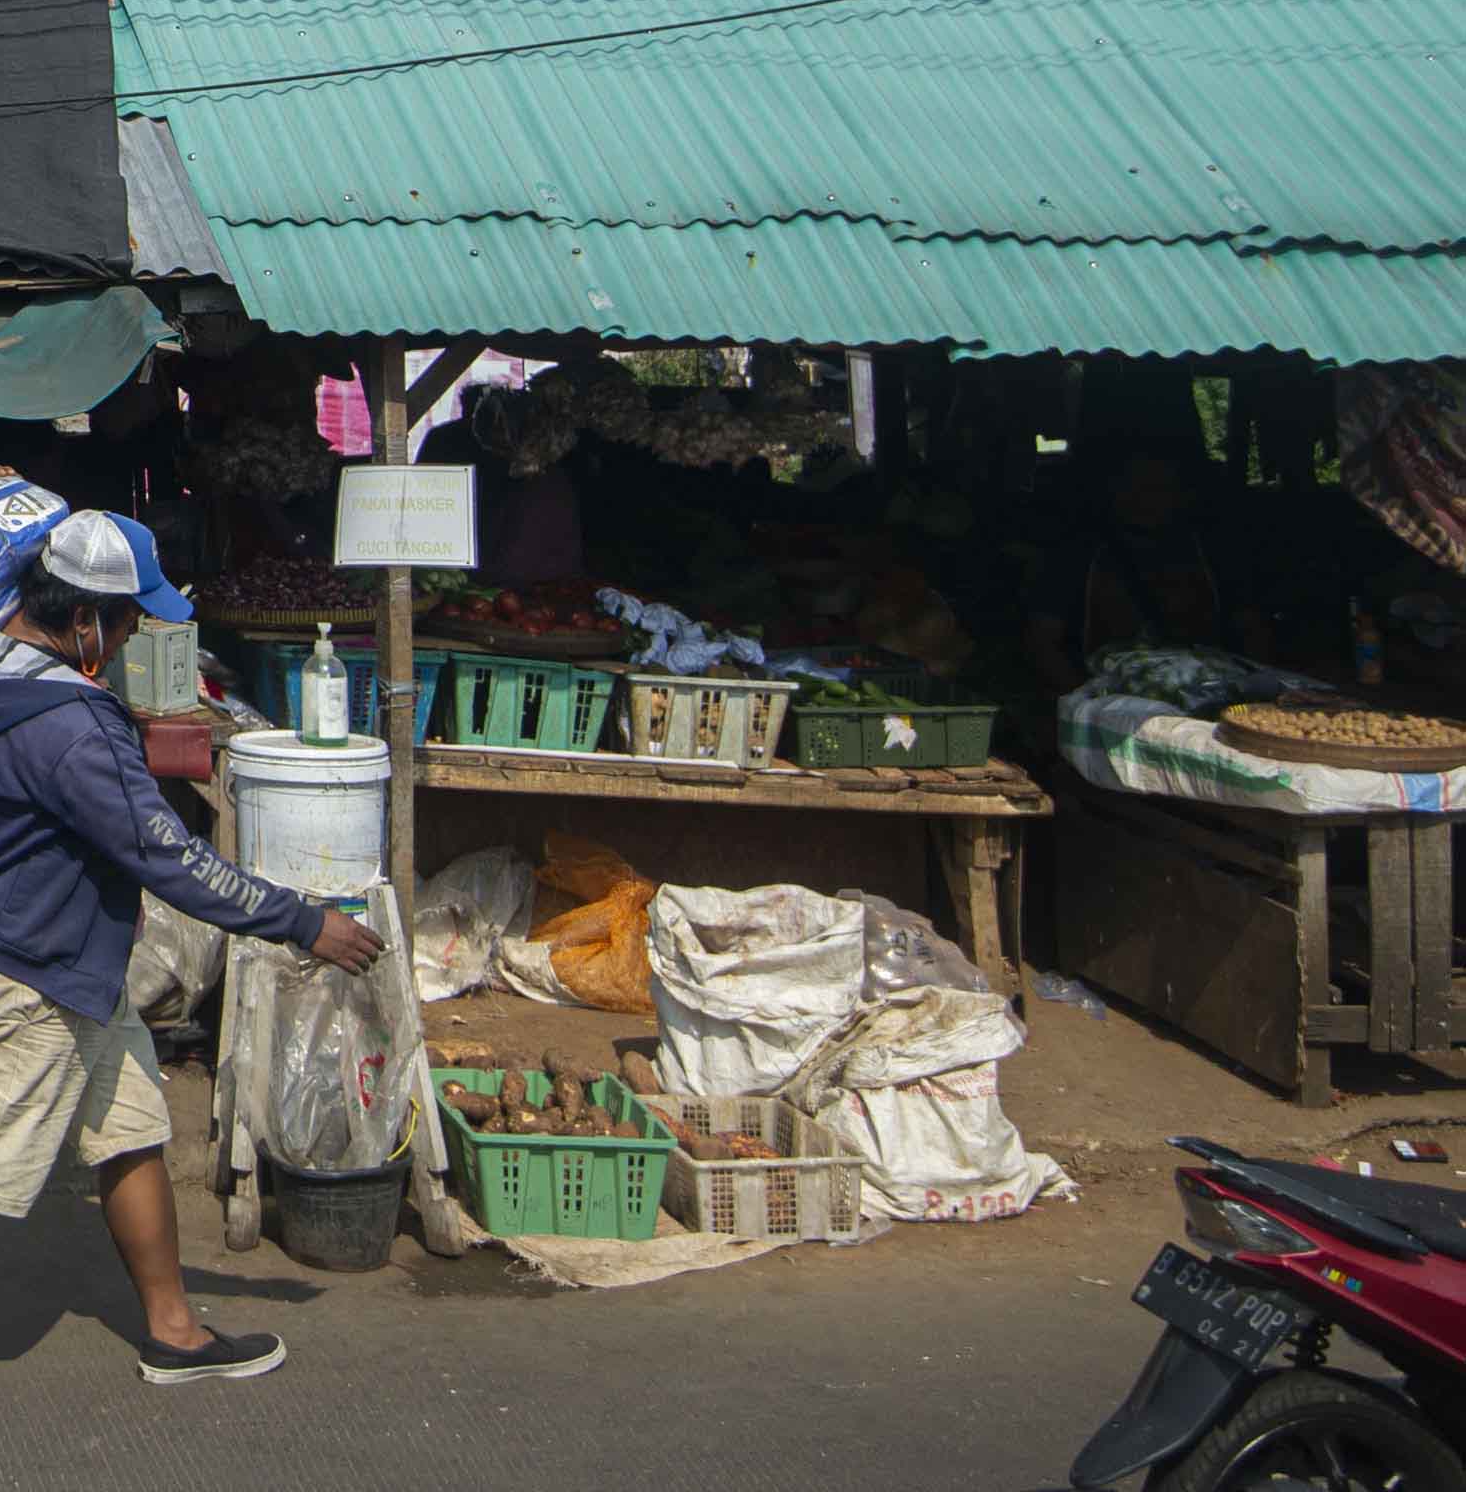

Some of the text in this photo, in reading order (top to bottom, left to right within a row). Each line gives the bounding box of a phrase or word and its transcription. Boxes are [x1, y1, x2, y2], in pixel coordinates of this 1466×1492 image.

[396, 496, 455, 511] MASKER
[395, 540, 453, 556] TANGAN
[1153, 1249, 1175, 1274] B
[1233, 1294, 1287, 1337] PQP
